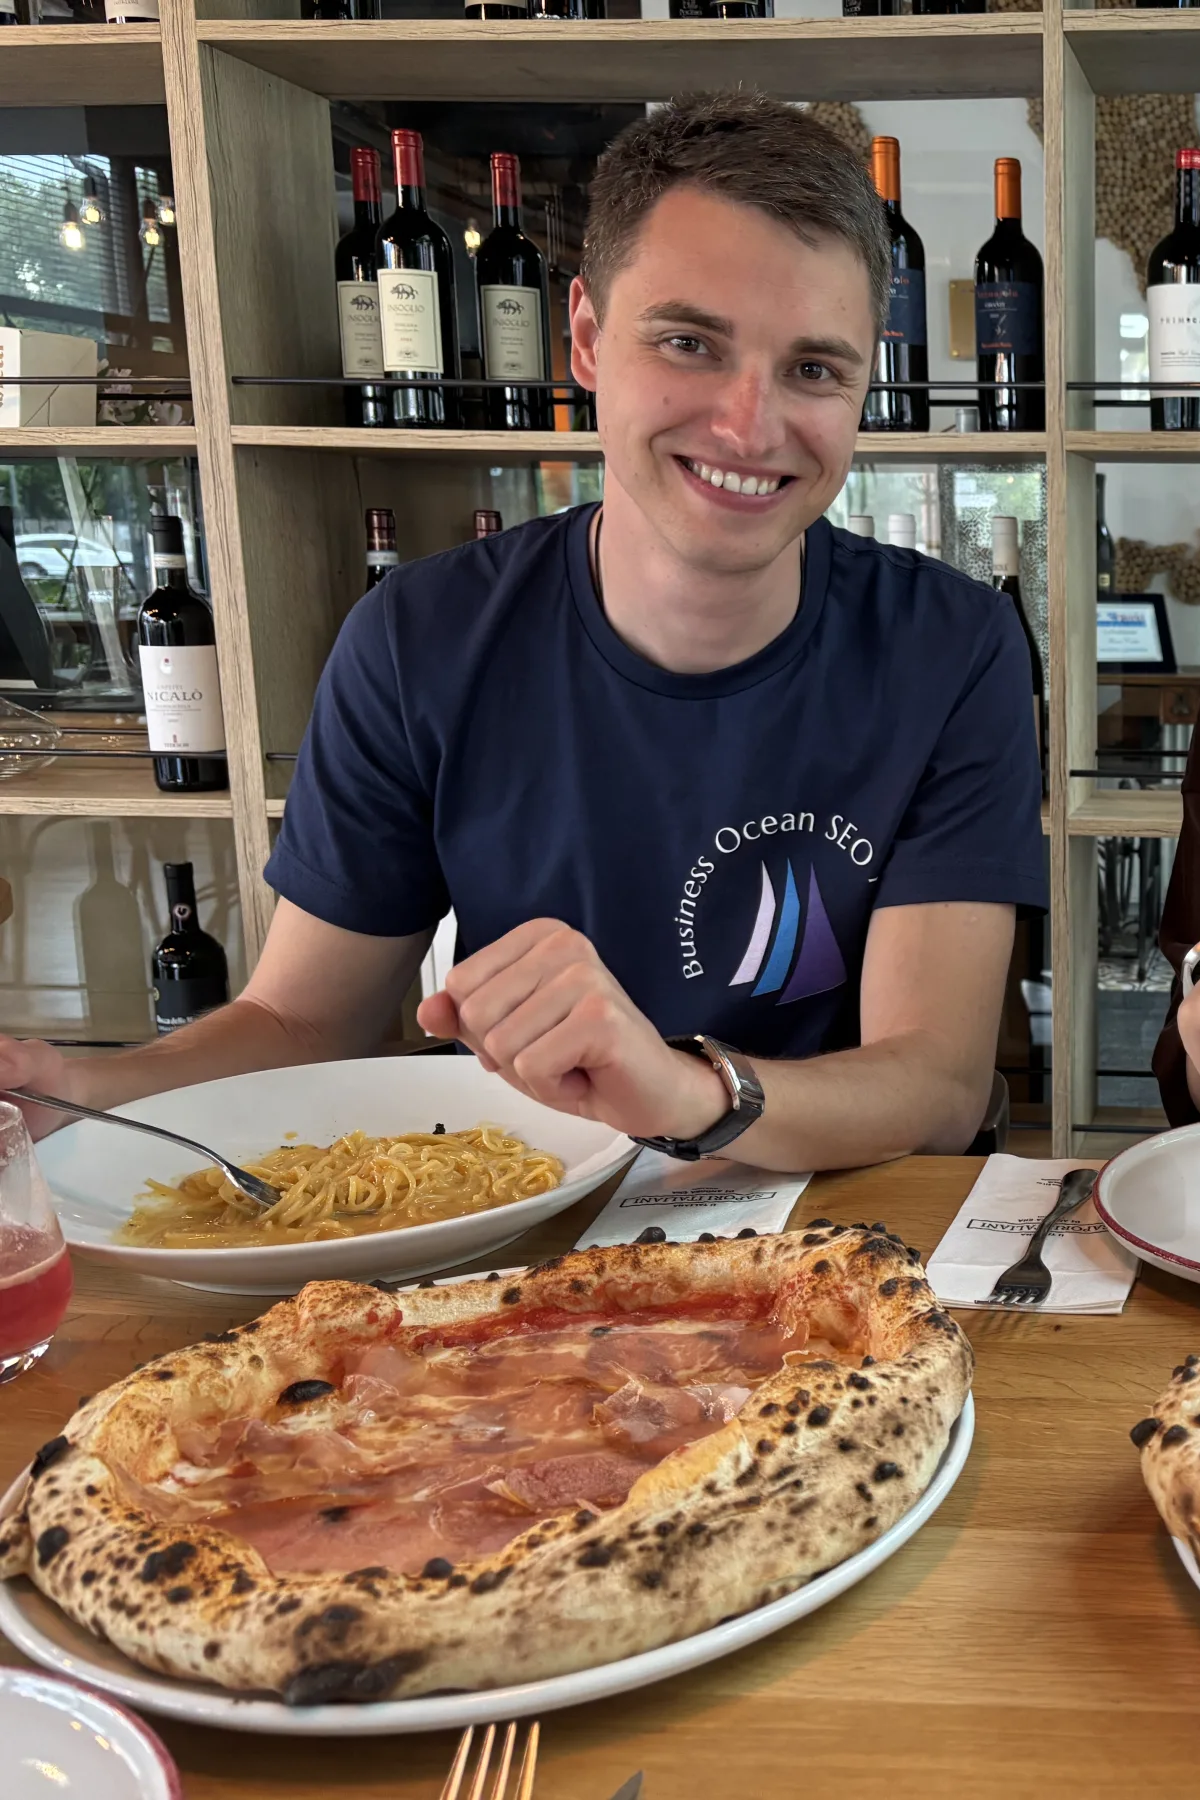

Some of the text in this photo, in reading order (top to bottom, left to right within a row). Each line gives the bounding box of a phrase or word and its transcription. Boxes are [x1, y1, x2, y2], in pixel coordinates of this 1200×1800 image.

[348, 314, 380, 323] INSOGLI
[674, 812, 874, 979] Business Ocean SEO
[633, 1193, 765, 1204] SAPORI ITALIANI
